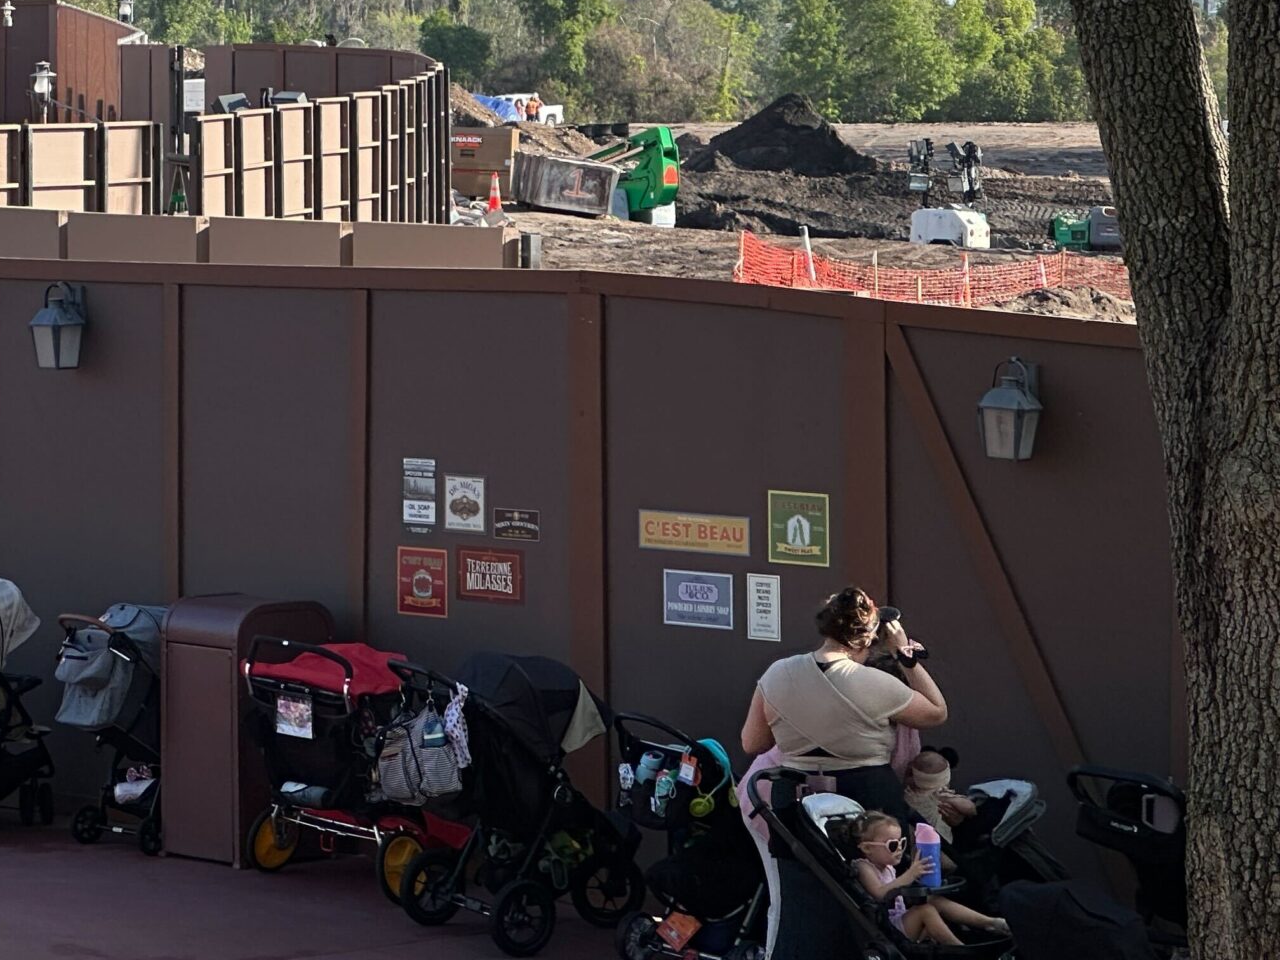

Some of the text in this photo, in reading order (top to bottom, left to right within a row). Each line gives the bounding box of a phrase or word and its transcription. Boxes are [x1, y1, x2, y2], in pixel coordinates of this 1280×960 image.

[644, 520, 744, 542] C'EST BEAU
[466, 573, 512, 594] MOLASSES
[667, 602, 729, 615] POWDERED LAUNDRY SOAP
